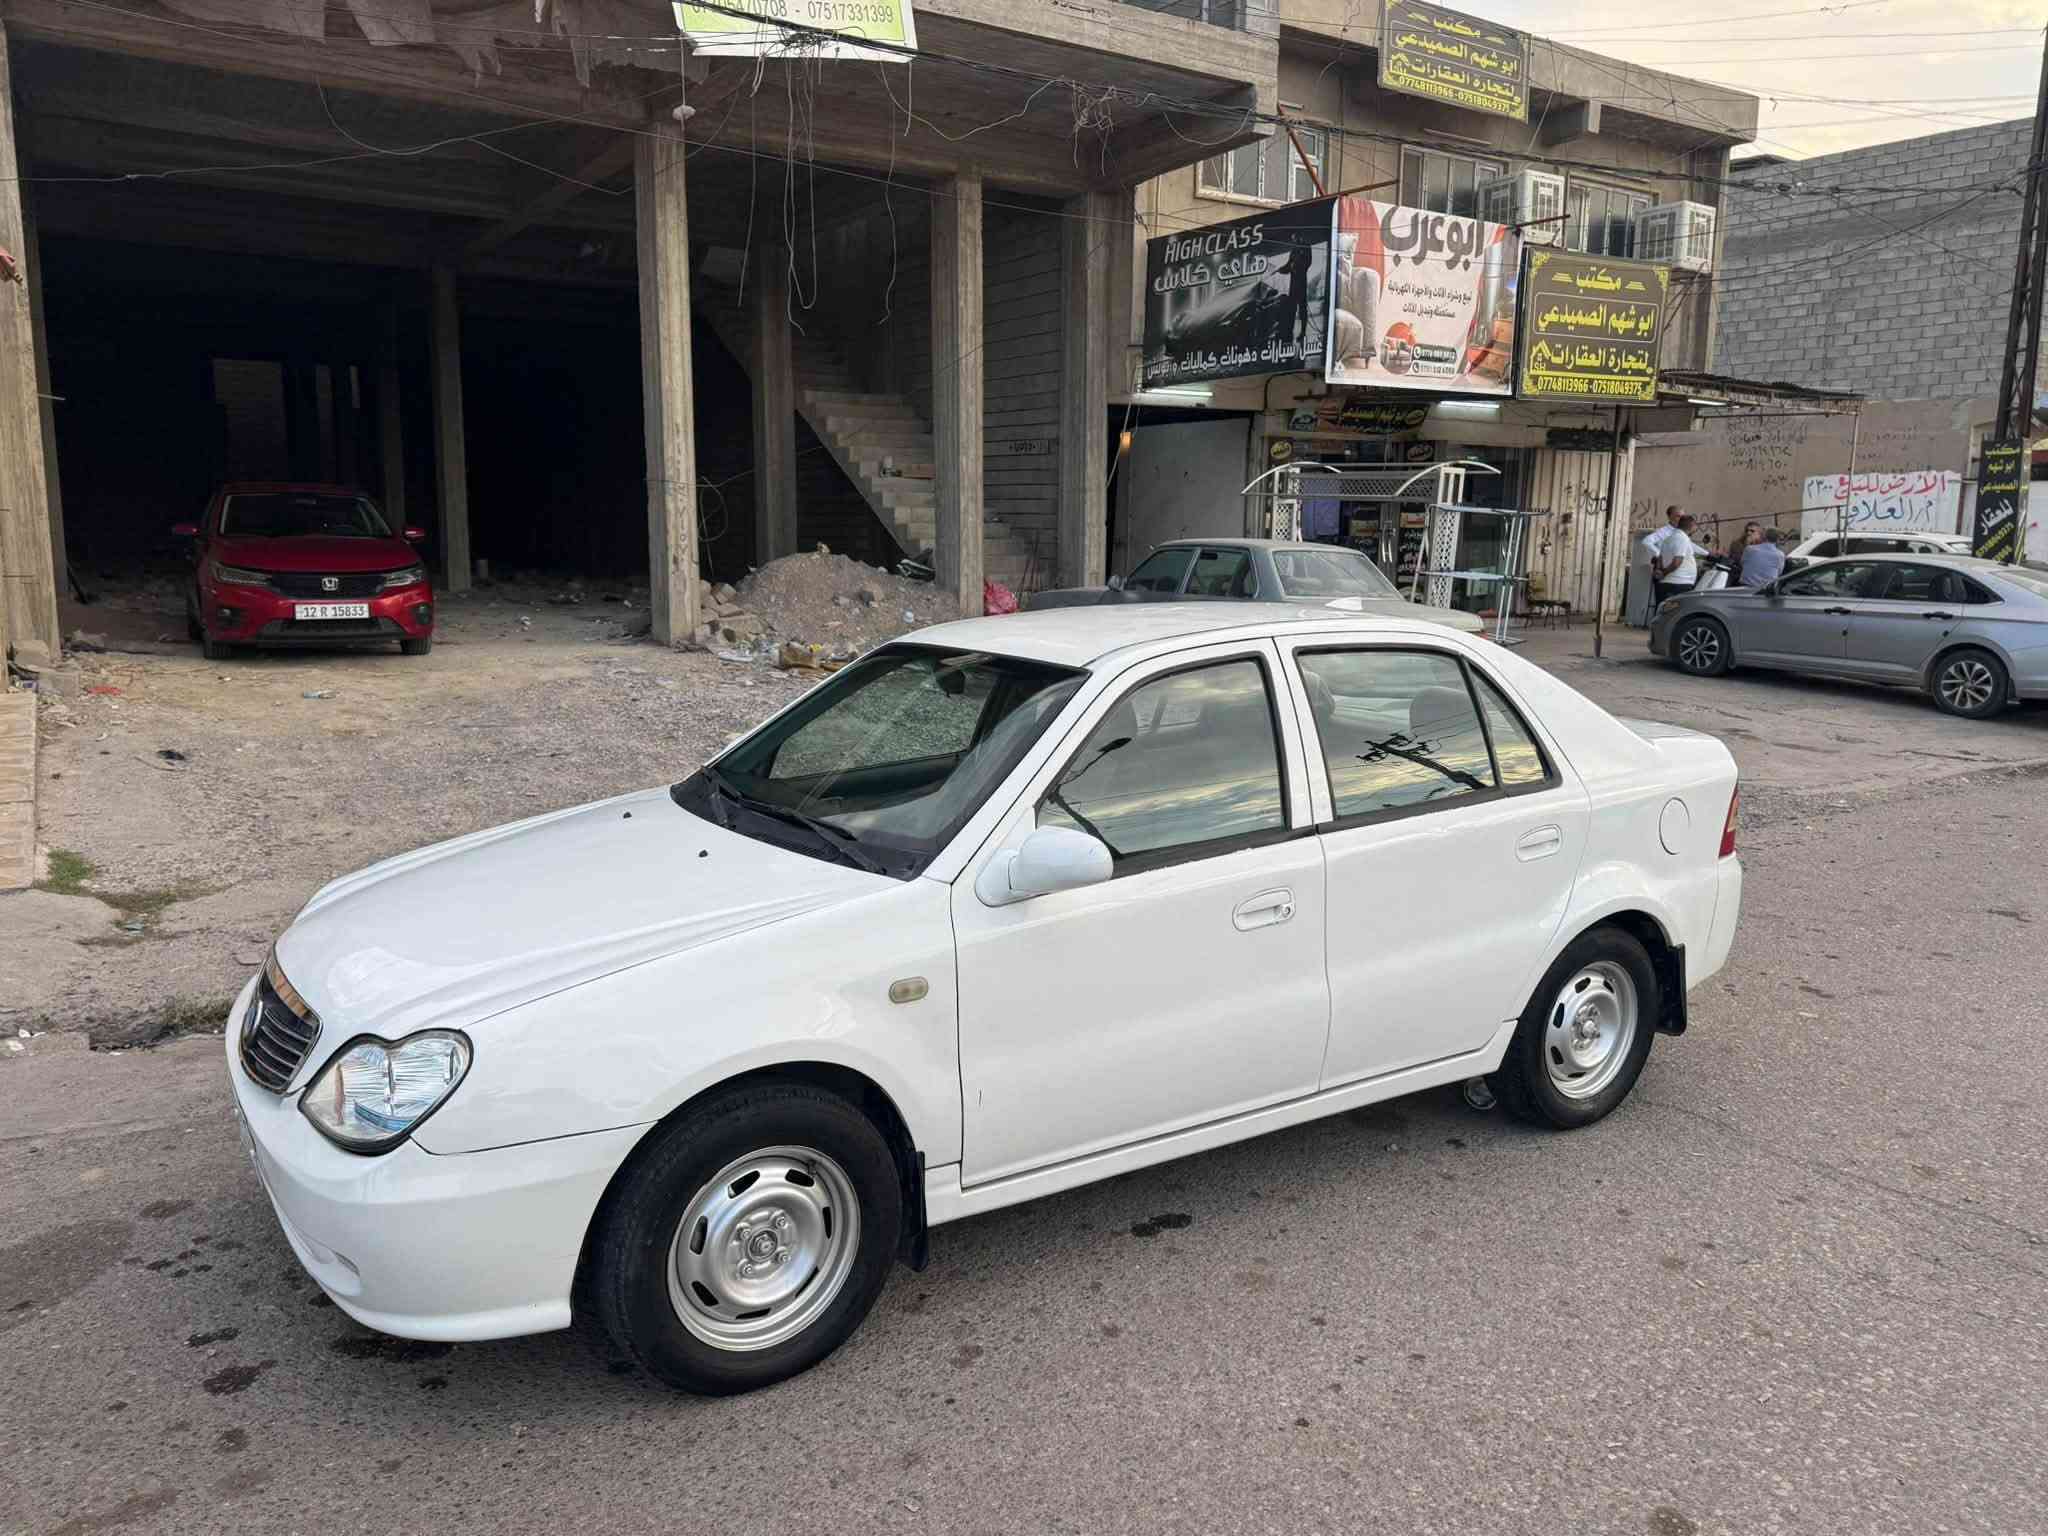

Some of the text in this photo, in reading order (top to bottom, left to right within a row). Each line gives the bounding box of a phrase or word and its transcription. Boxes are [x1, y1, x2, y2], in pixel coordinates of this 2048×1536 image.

[807, 1, 894, 23] 07517331399
[1433, 16, 1481, 37] مكتب
[1410, 58, 1470, 85] العقارات
[1470, 50, 1499, 69] شهم
[1164, 223, 1264, 264] HIGH CLASS
[1154, 253, 1268, 292] هاي كلاس
[1576, 266, 1622, 293] مكتب
[1538, 303, 1655, 337] ابو شهم الصميدعي
[1261, 339, 1296, 364] سيارات
[1300, 335, 1323, 361] غسل
[1550, 344, 1650, 374] لتجارة العقارات
[1181, 351, 1217, 374] كماليات
[303, 605, 365, 617] 12 R 15833
